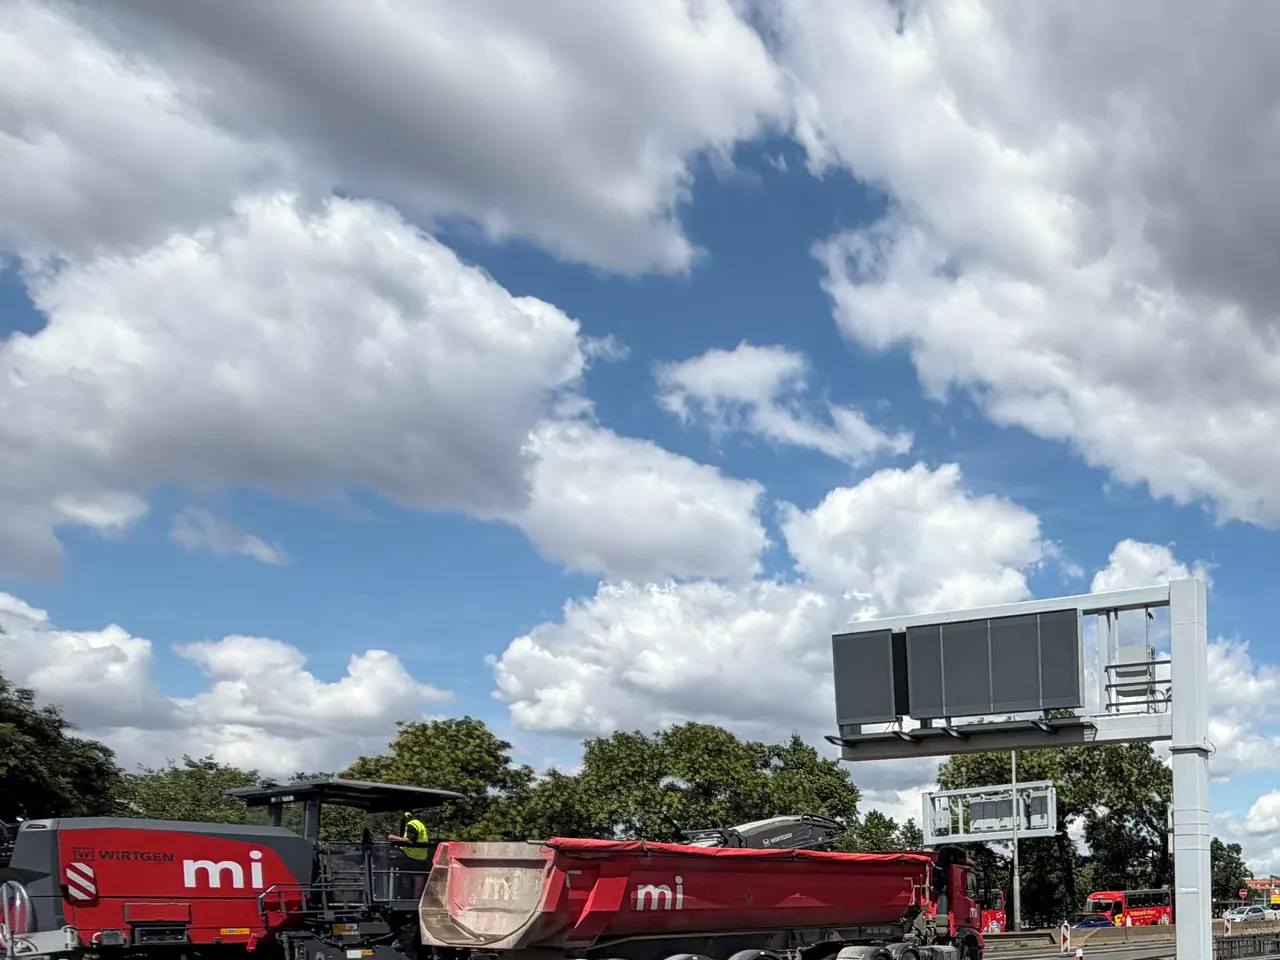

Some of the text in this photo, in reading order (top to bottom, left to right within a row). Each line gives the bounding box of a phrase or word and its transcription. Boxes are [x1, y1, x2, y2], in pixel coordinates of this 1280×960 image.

[99, 850, 174, 862] WIRTGEN
[183, 850, 264, 888] mi
[636, 875, 684, 911] mi
